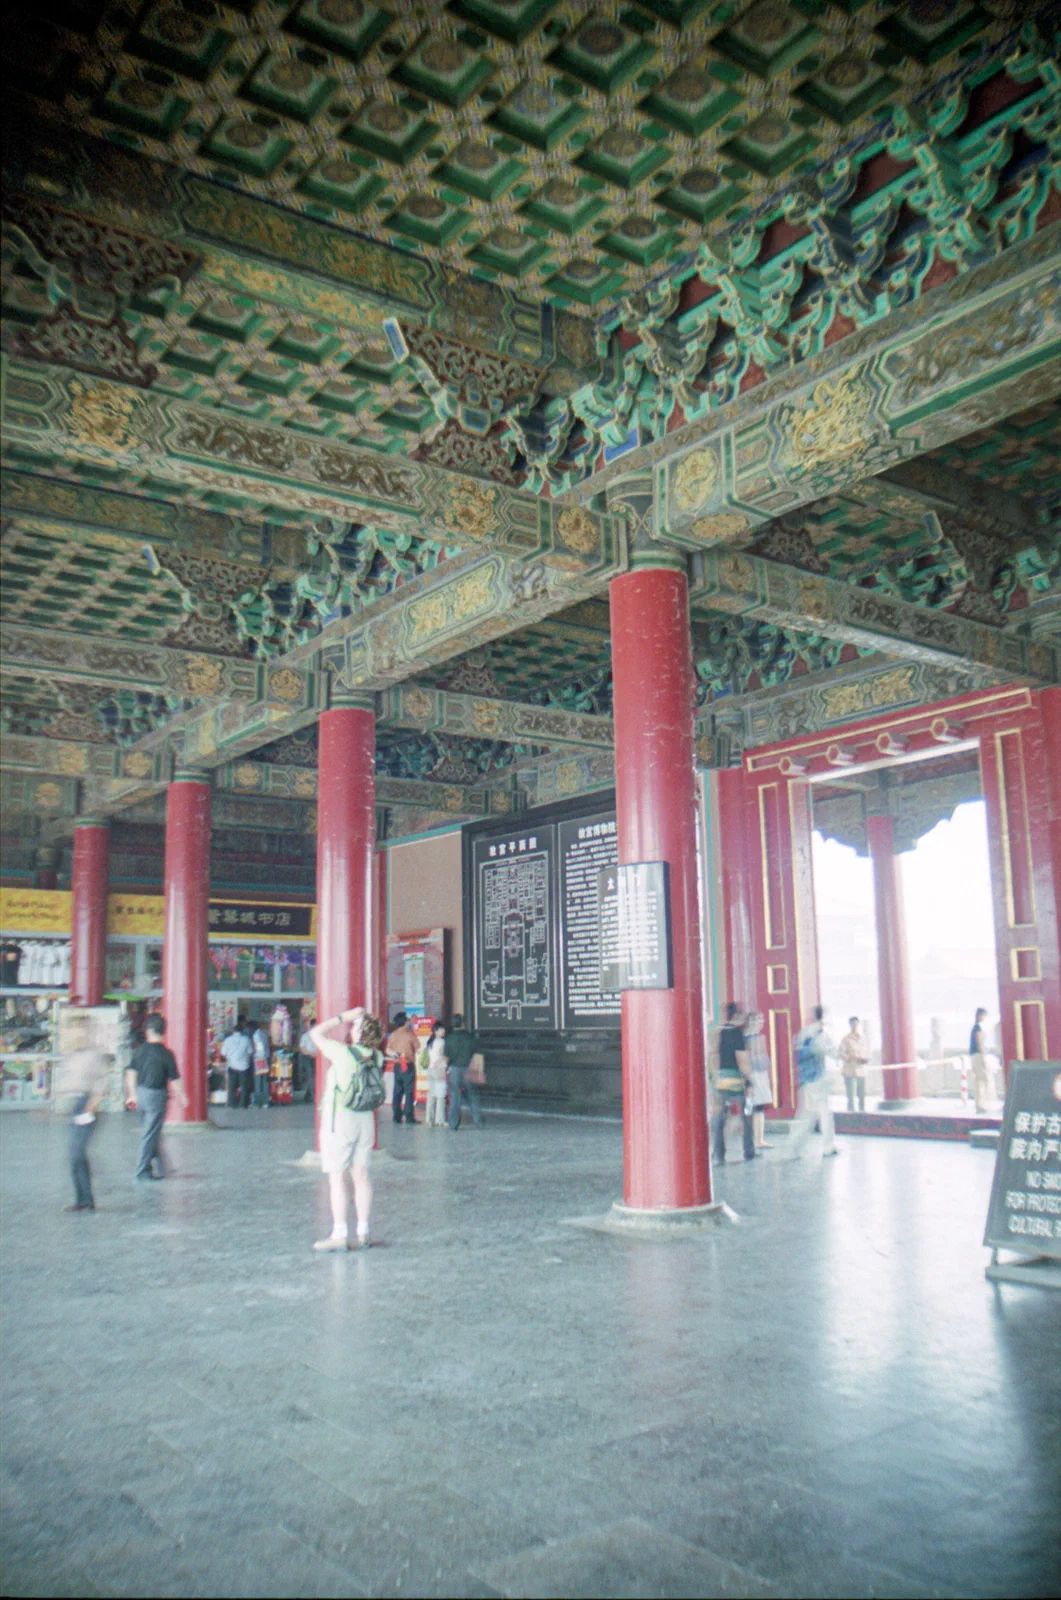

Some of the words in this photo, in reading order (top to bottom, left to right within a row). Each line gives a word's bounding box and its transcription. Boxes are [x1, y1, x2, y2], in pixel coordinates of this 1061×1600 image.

[1008, 1137, 1061, 1161] 院内严
[1026, 1170, 1041, 1188] NO
[1005, 1190, 1025, 1210] FOR
[1008, 1214, 1053, 1237] CULTURAL
